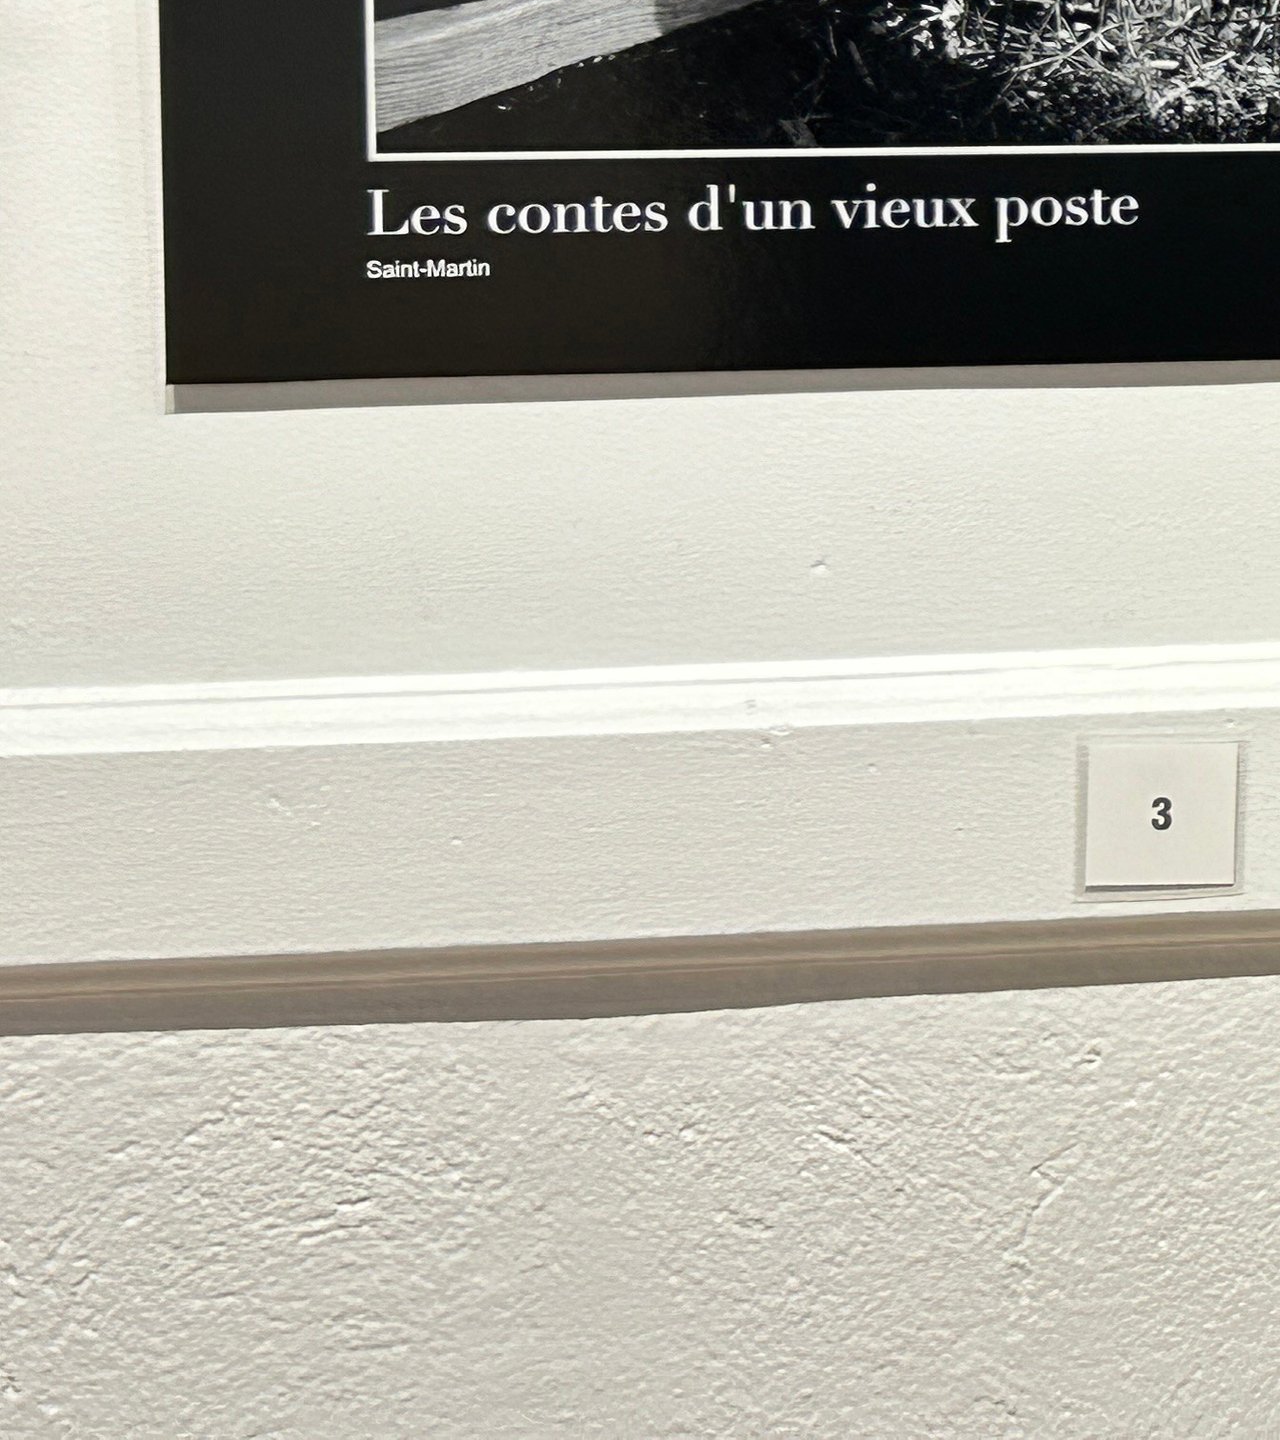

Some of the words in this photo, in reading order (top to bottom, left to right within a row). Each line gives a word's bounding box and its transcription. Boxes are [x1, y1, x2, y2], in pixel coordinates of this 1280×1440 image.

[366, 188, 469, 237] Les
[486, 195, 669, 235] contes
[687, 183, 816, 232] d'un
[830, 182, 980, 230] vieux
[994, 188, 1140, 244] poste
[366, 258, 491, 280] Saint-Martin
[1151, 796, 1173, 831] 3
